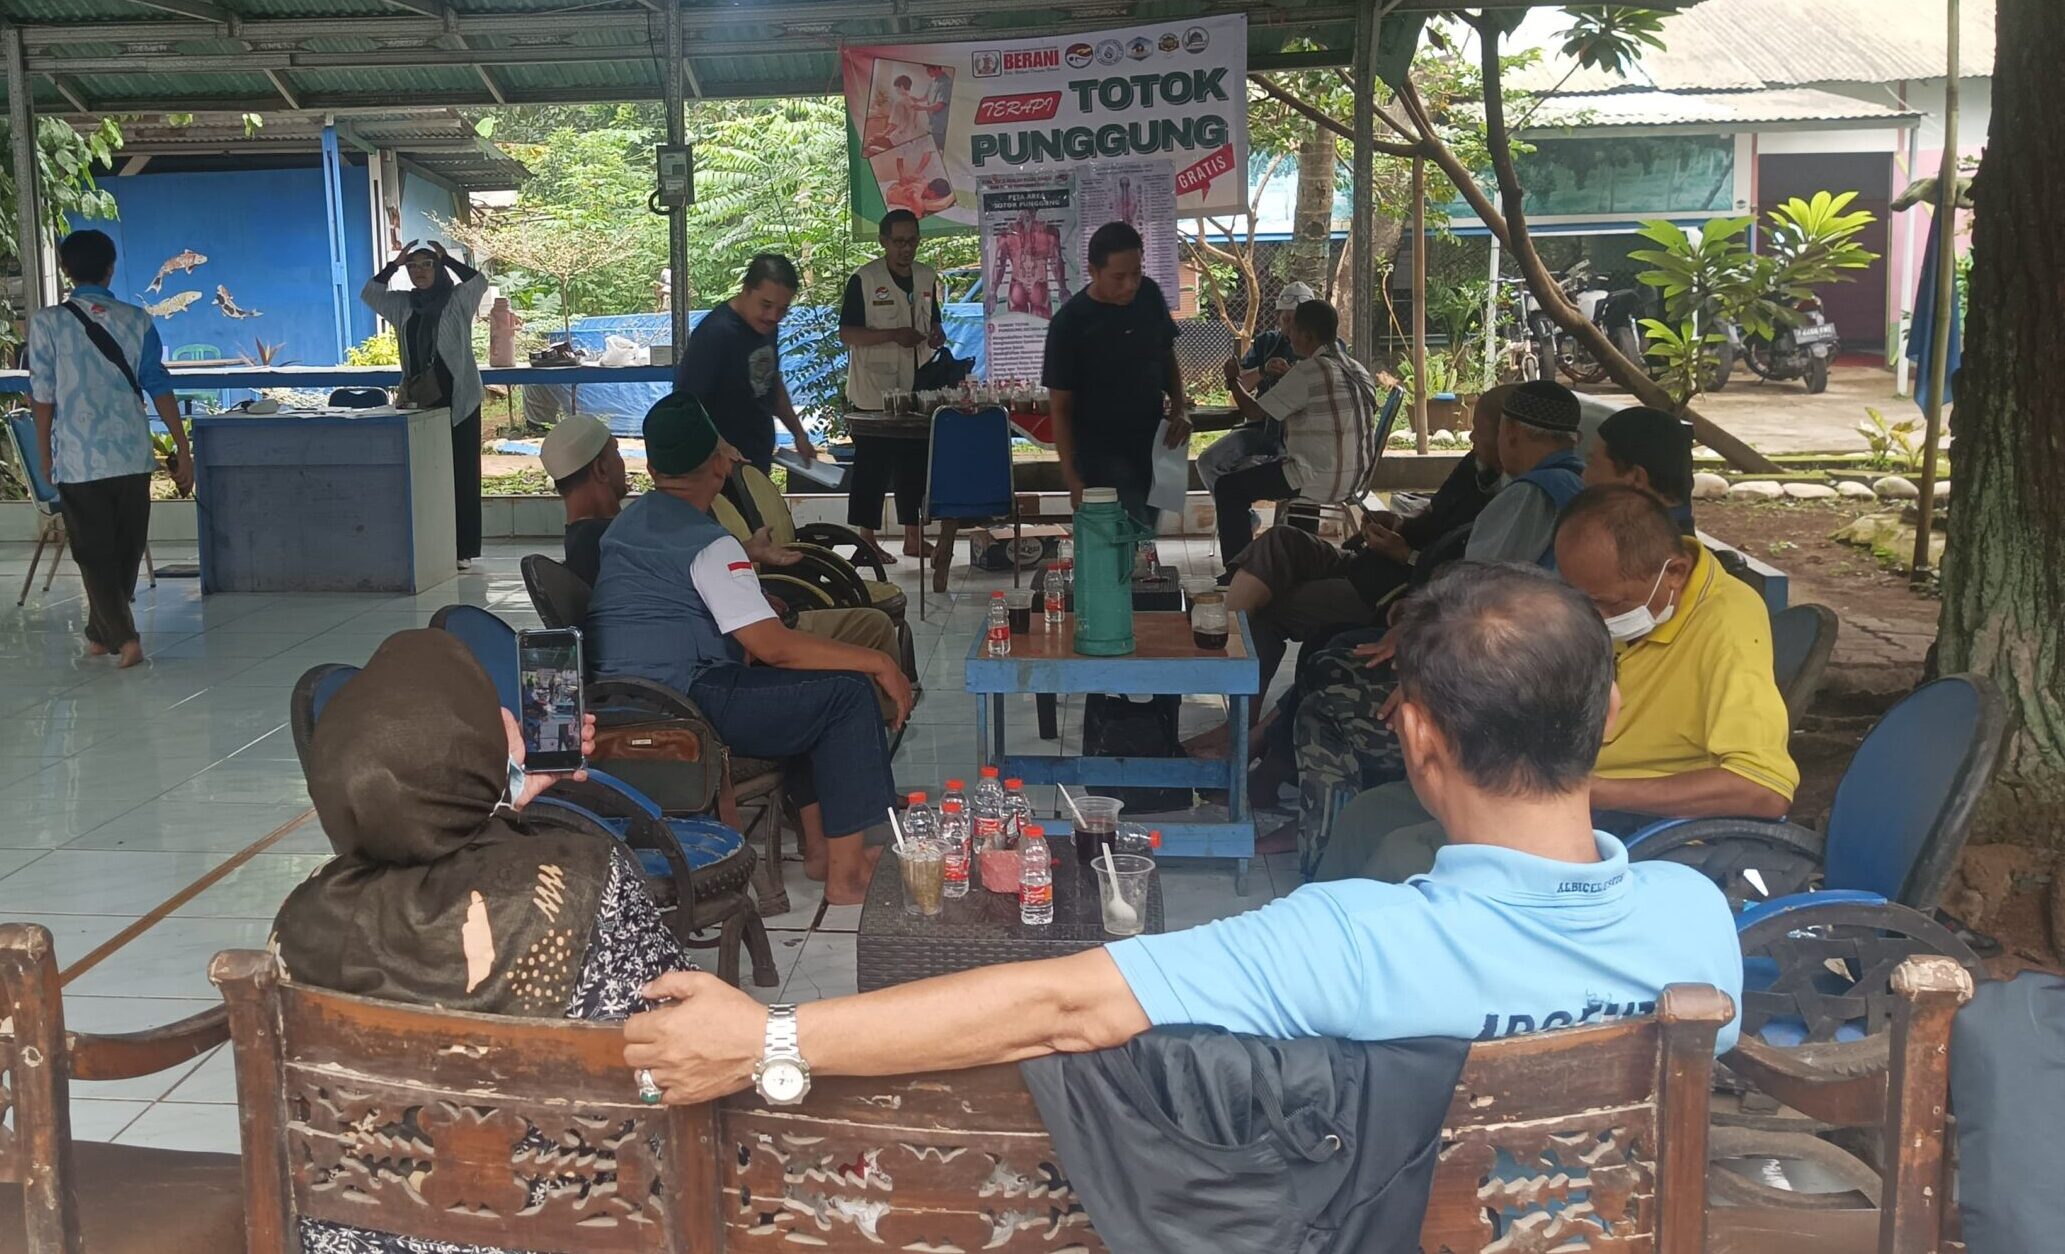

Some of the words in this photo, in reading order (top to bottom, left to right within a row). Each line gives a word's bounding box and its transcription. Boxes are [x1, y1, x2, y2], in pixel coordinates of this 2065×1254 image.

[1003, 49, 1059, 70] BERANI
[1068, 67, 1229, 113] TOTOK
[982, 97, 1054, 118] TERAPI
[971, 114, 1229, 167] PUNGGUNG
[1177, 155, 1227, 189] GRATIS
